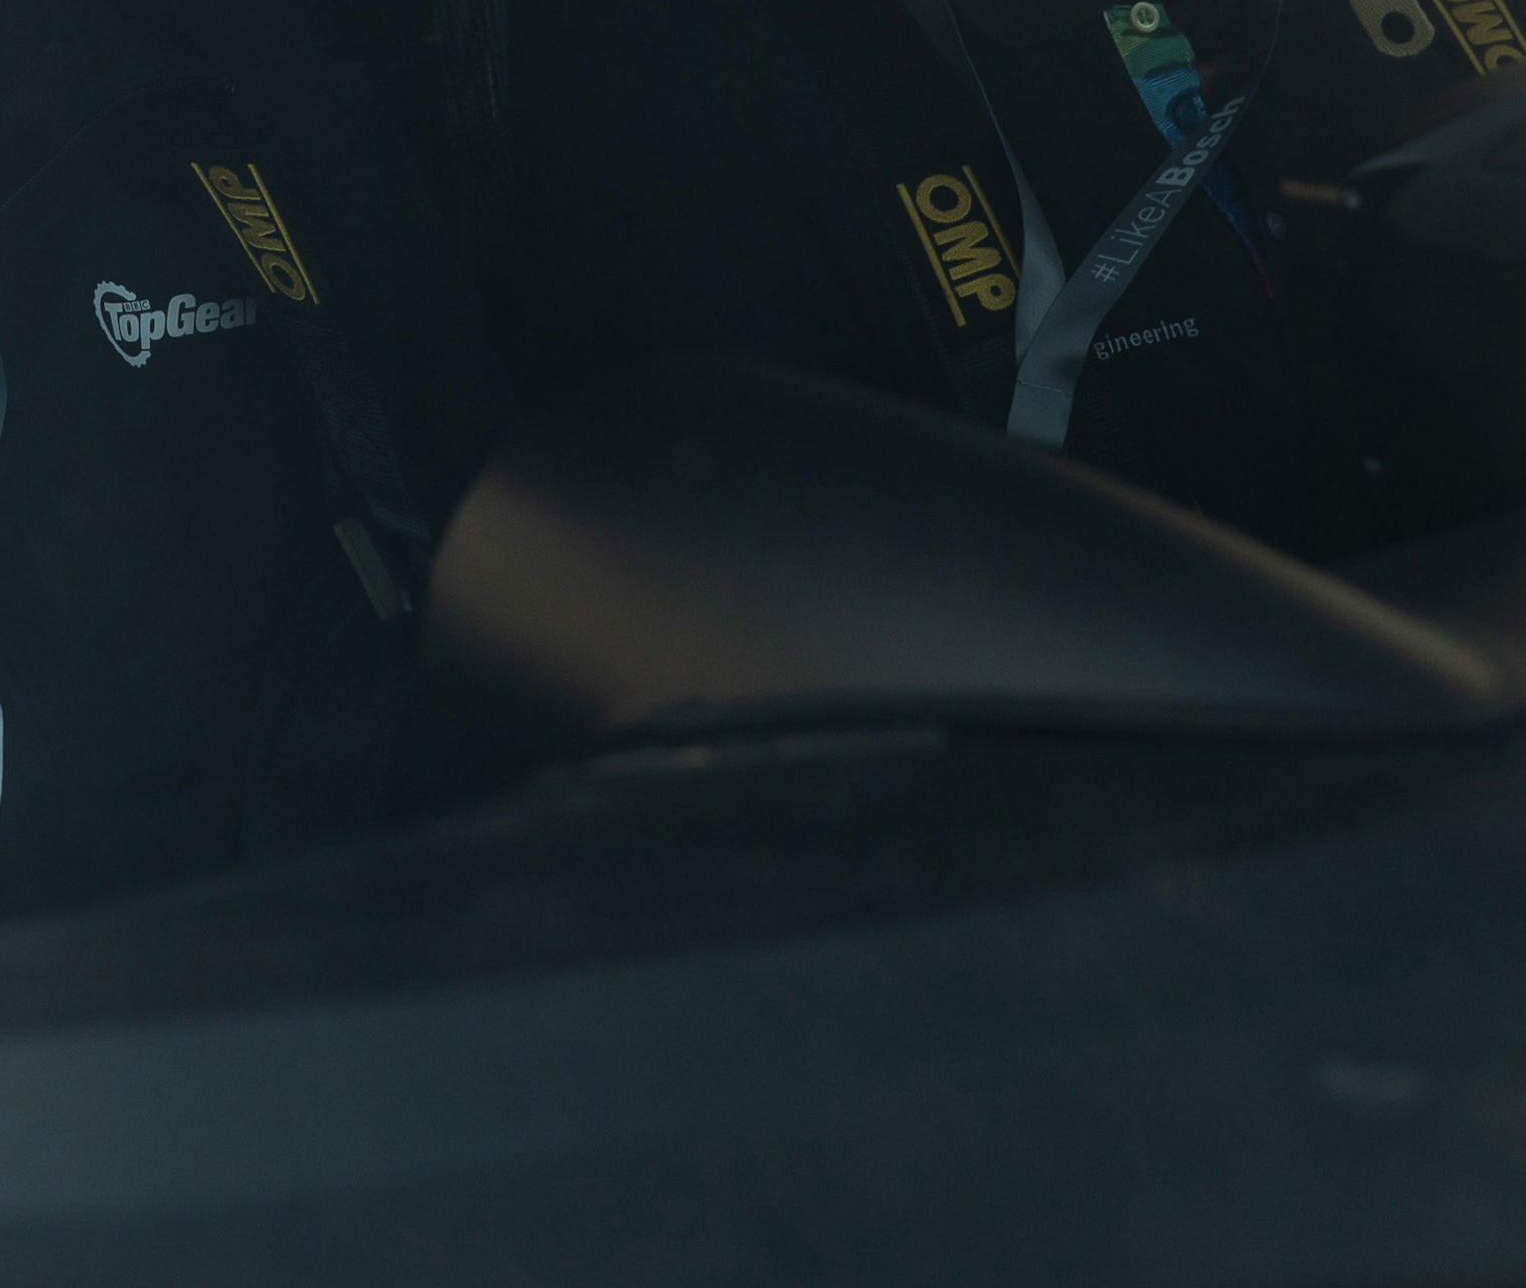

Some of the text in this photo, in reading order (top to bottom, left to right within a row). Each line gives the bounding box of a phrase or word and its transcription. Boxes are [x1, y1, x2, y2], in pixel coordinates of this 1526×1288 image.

[208, 165, 306, 301] OMP
[915, 173, 1017, 311] OMP
[1089, 95, 1247, 283] #LikeABosch
